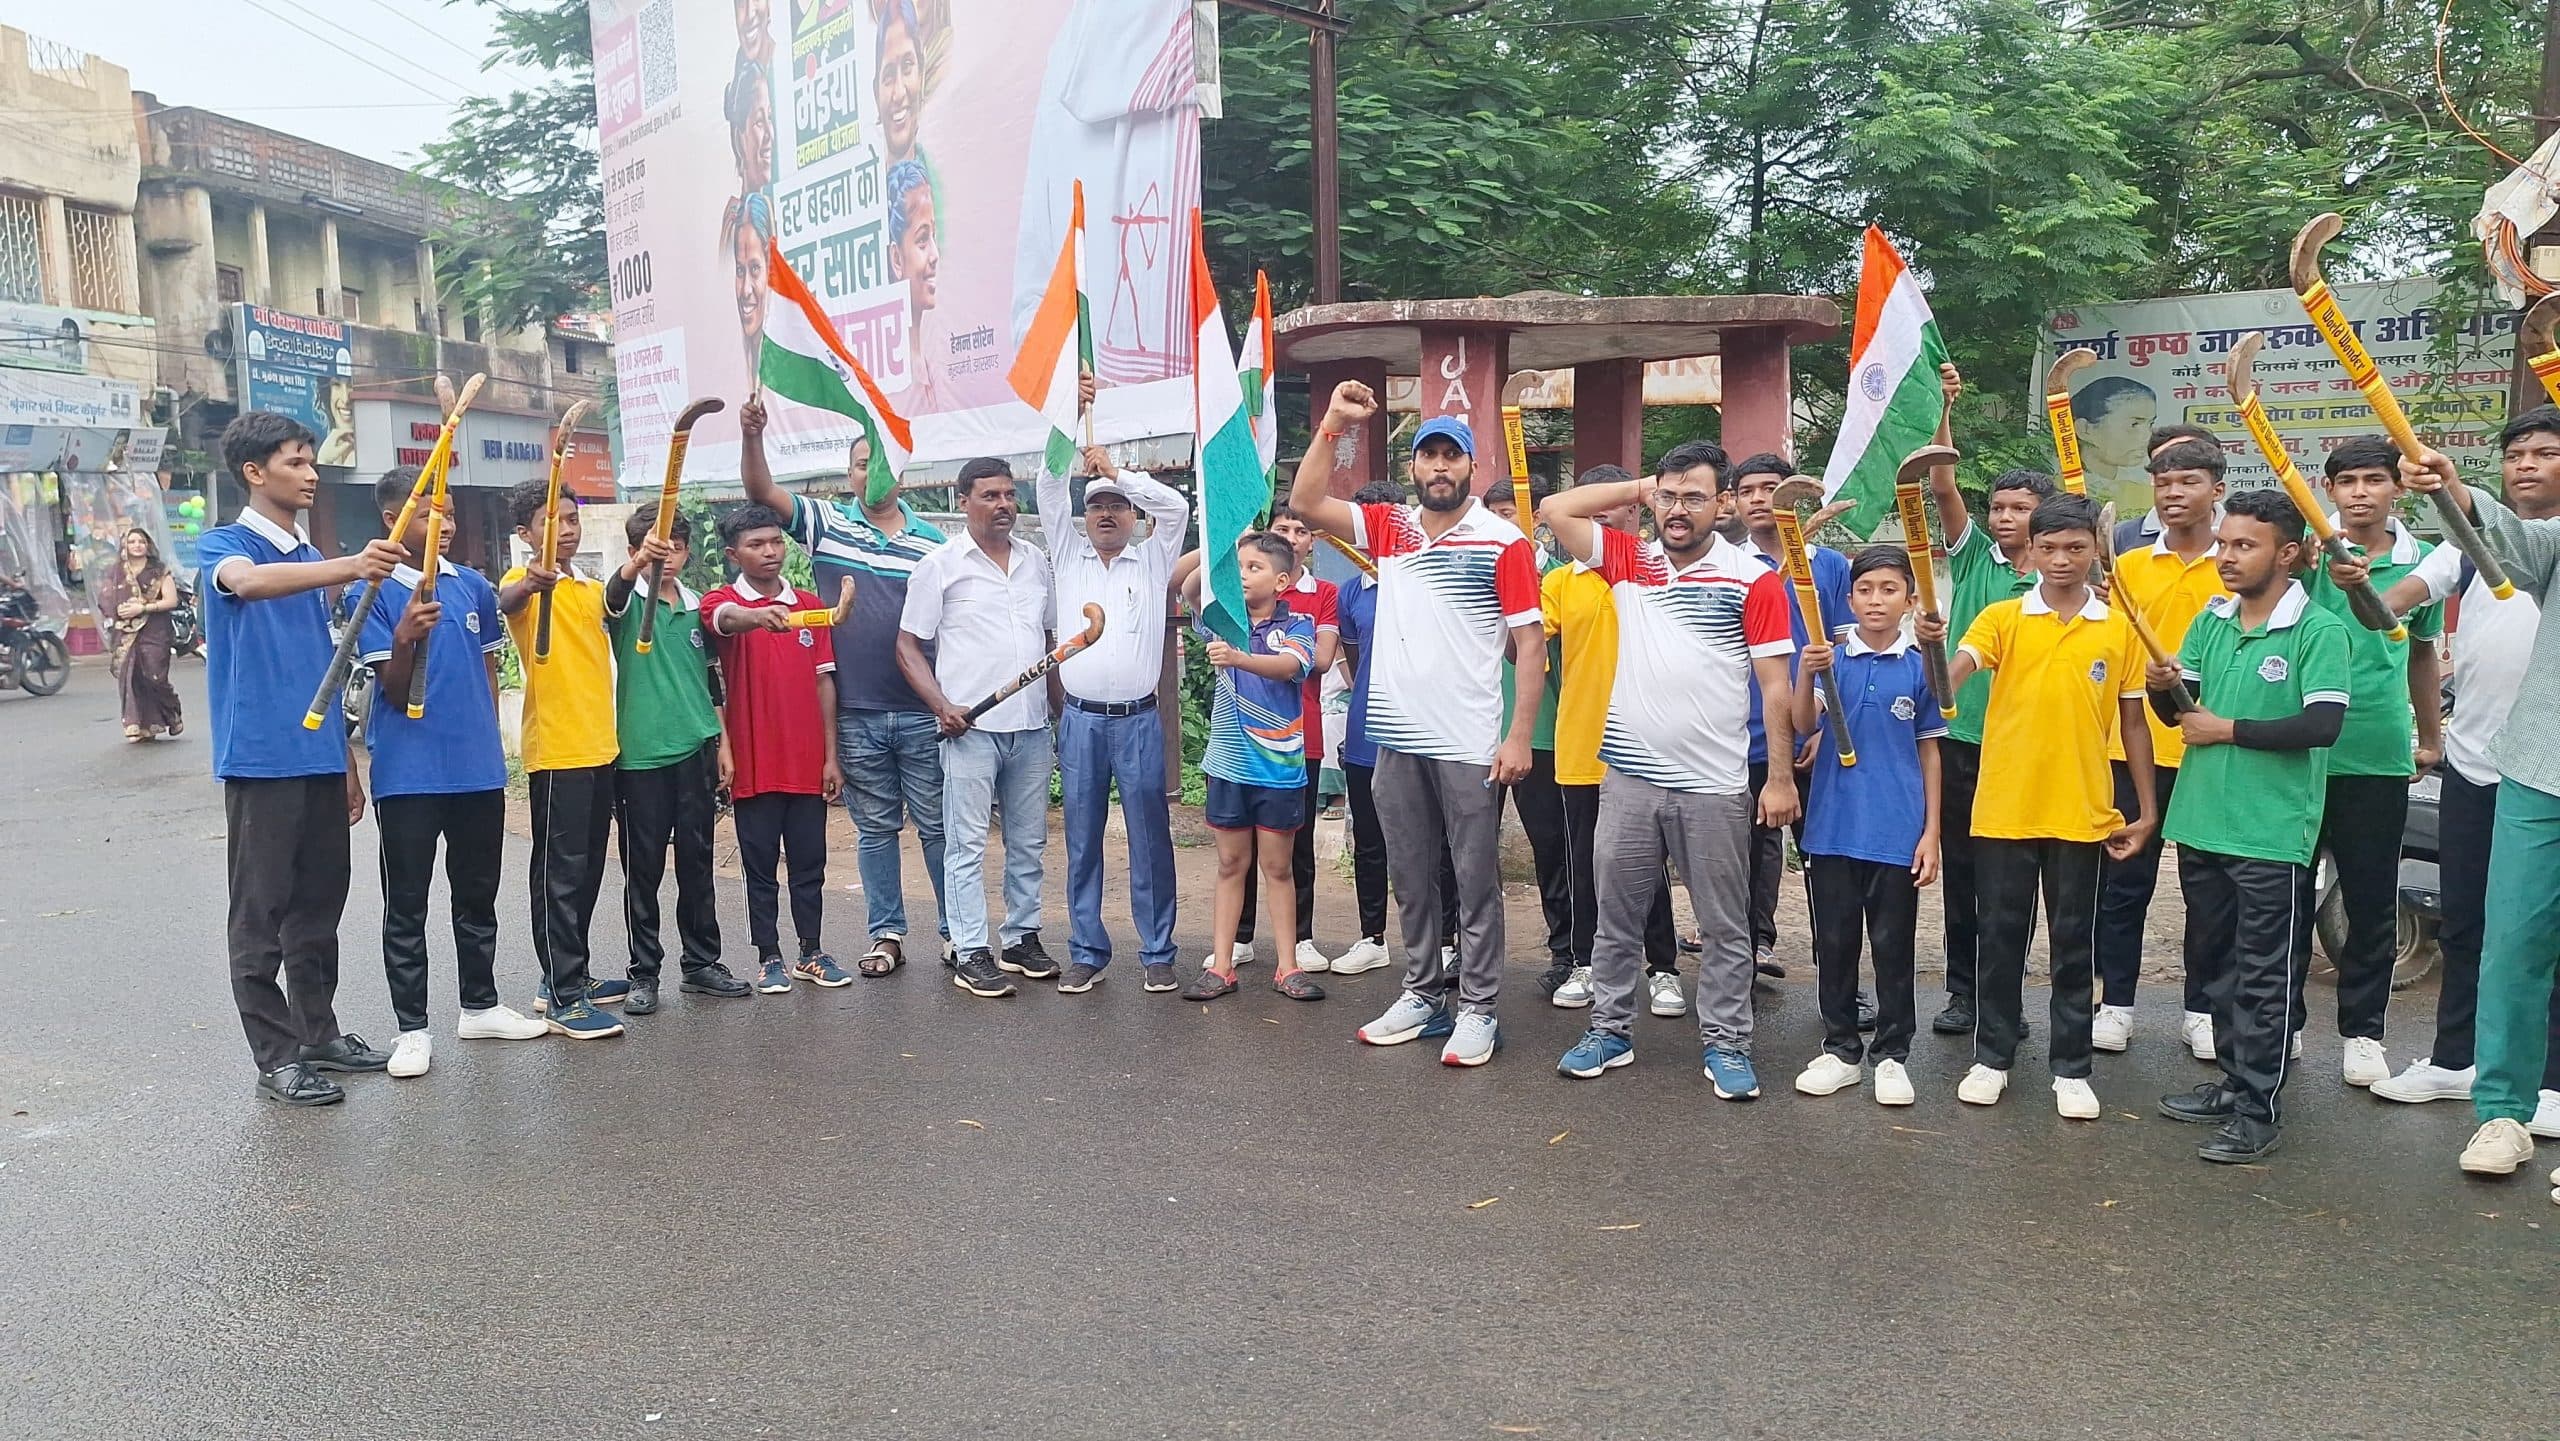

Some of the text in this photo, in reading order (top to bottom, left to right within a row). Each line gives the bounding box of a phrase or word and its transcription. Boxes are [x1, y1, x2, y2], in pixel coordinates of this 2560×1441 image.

[780, 144, 880, 237] हर बहना को
[821, 220, 882, 299] साल
[830, 299, 904, 379] जार
[2126, 332, 2192, 366] कुष्ठ
[2197, 319, 2366, 354] जारूका
[2322, 305, 2366, 371] World Wonder
[2172, 364, 2202, 378] कोई
[2206, 361, 2228, 375] दा
[2252, 357, 2300, 372] जिसमें
[2304, 359, 2344, 373] सूनाप
[2173, 382, 2198, 400] तो
[2270, 380, 2321, 397] जल्द
[2056, 409, 2076, 465] World Wonder
[2195, 411, 2219, 425] यह
[2300, 406, 2325, 420] का
[2220, 439, 2248, 456] ल्द
[2225, 462, 2270, 475] ानकारी
[1783, 526, 1805, 575] World Wonder
[1018, 653, 1058, 687] ALFA
